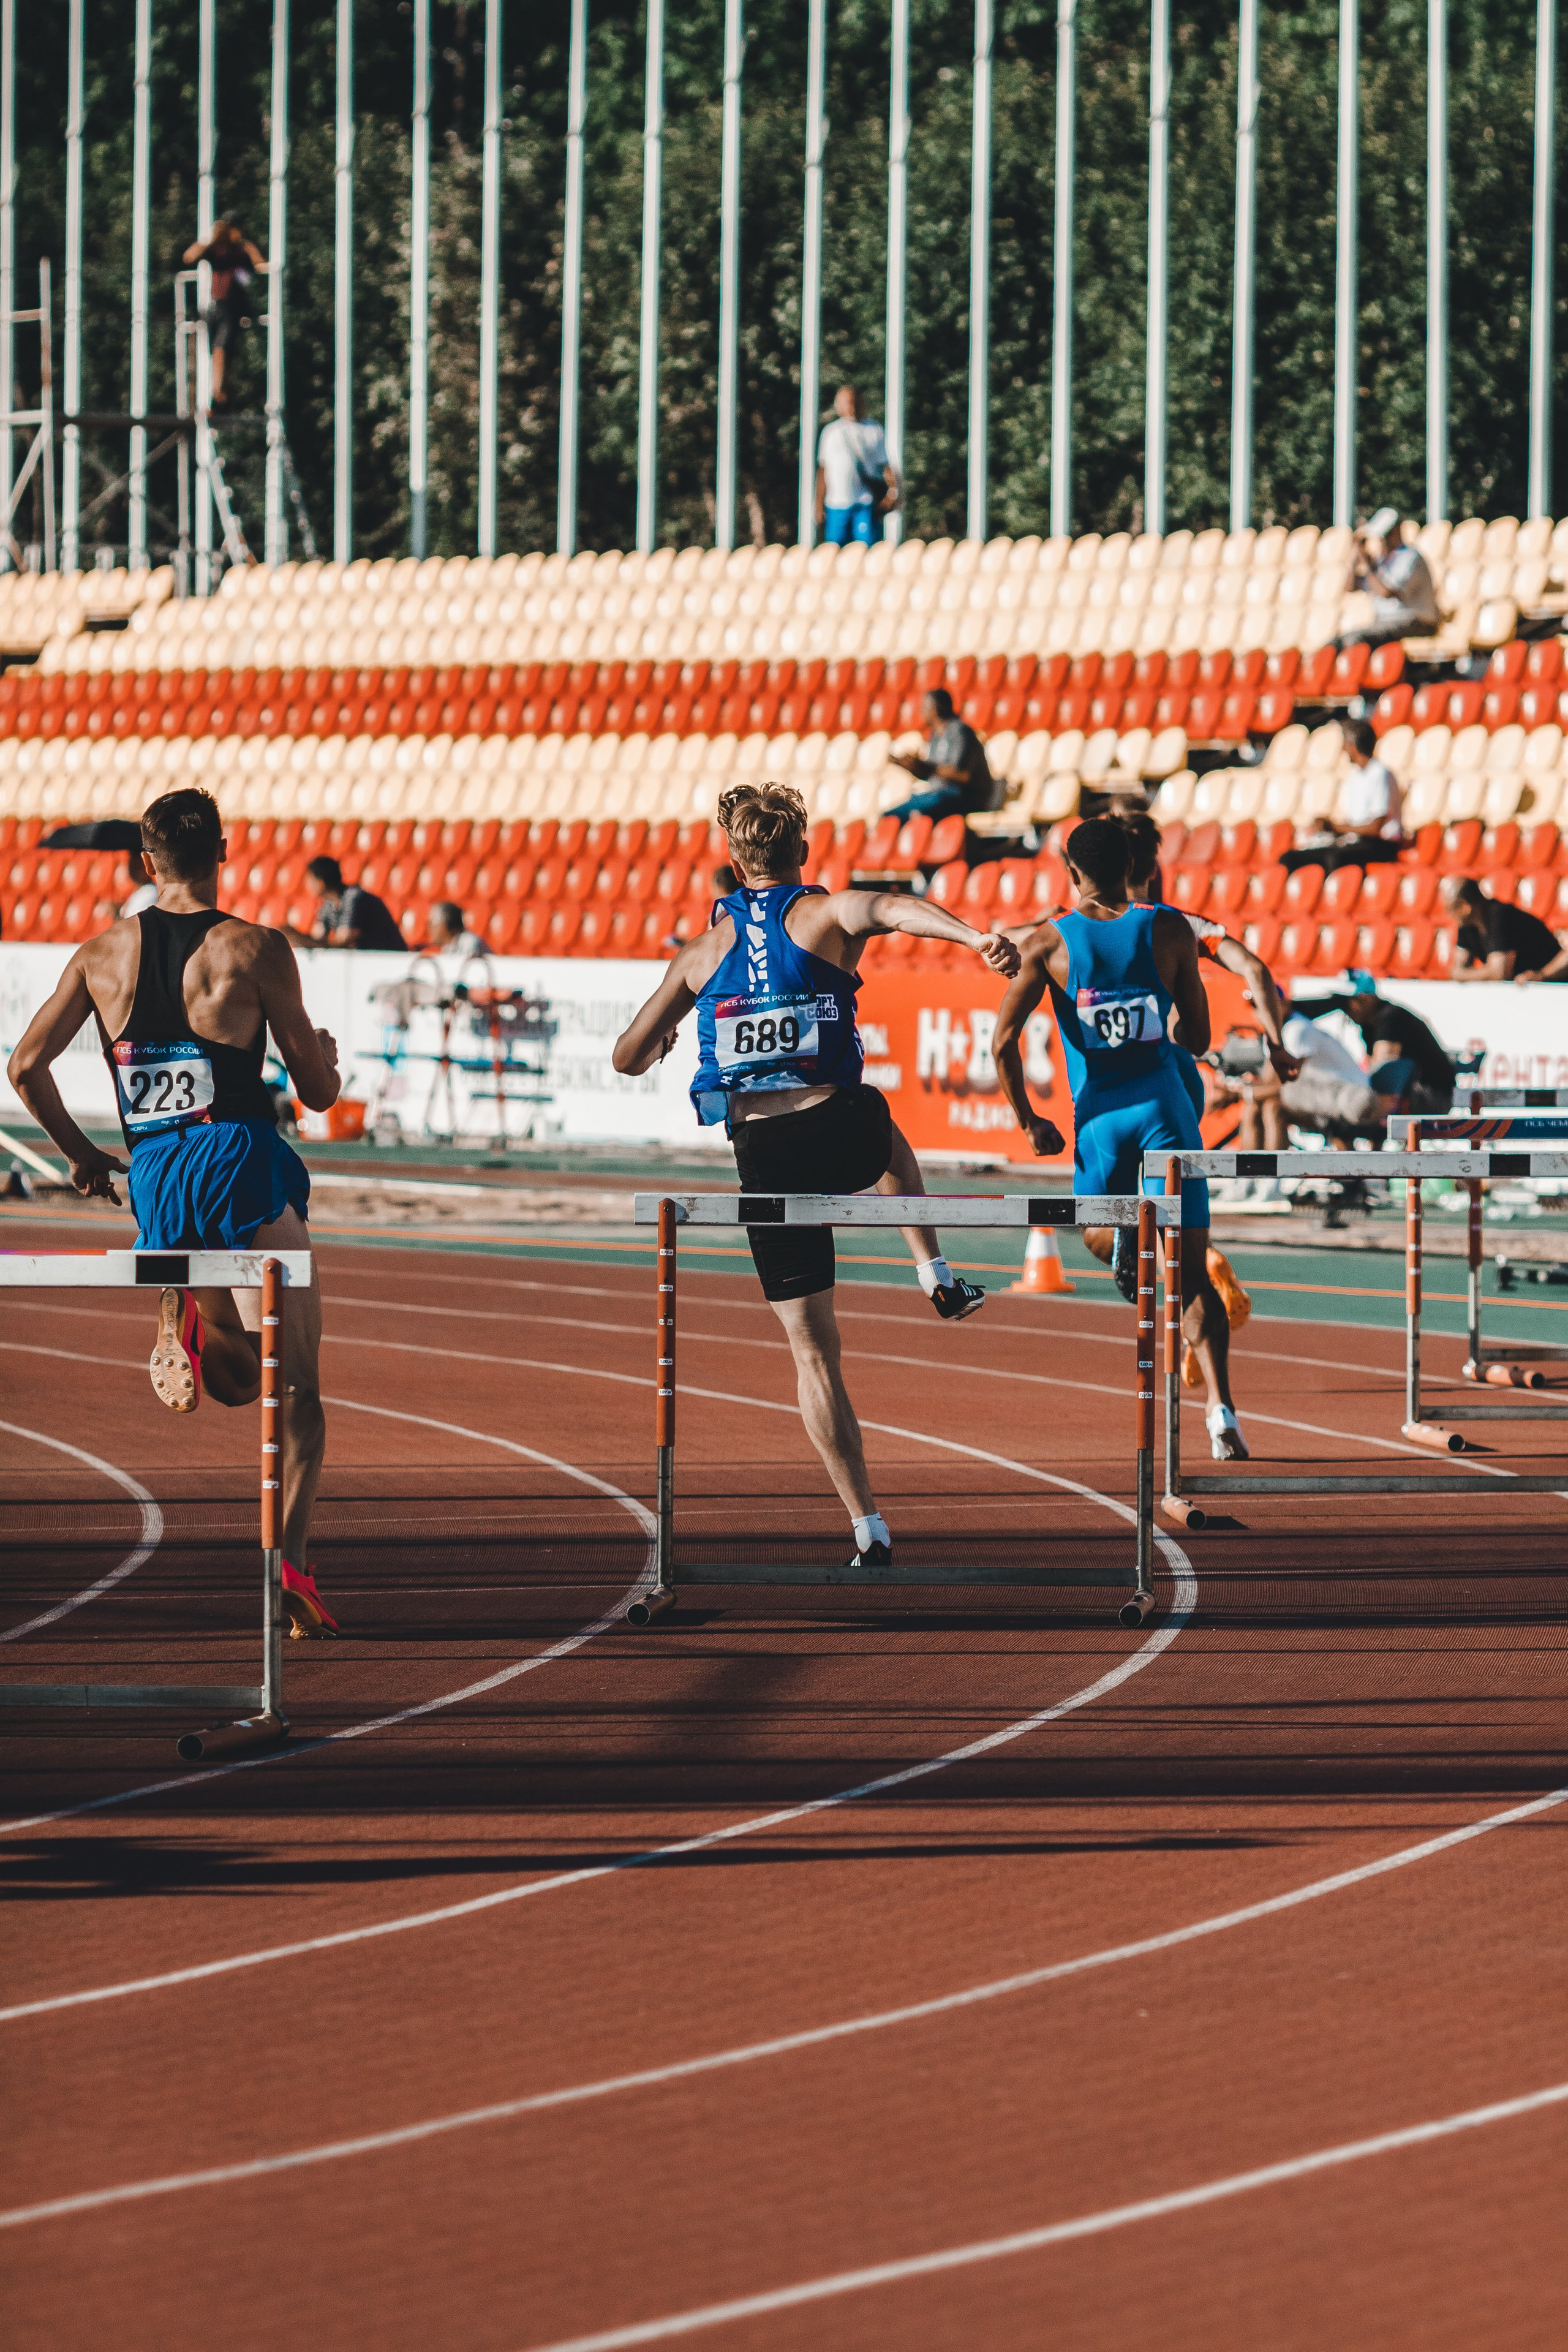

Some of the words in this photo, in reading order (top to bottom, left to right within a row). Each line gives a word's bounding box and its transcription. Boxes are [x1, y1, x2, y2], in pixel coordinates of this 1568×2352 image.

[740, 996, 770, 1005] КУБОК
[806, 1007, 838, 1019] СОЮЗ
[1094, 1005, 1145, 1041] 697
[734, 1016, 800, 1055] 689
[170, 1046, 203, 1055] РОССИИ
[130, 1069, 195, 1115] 223
